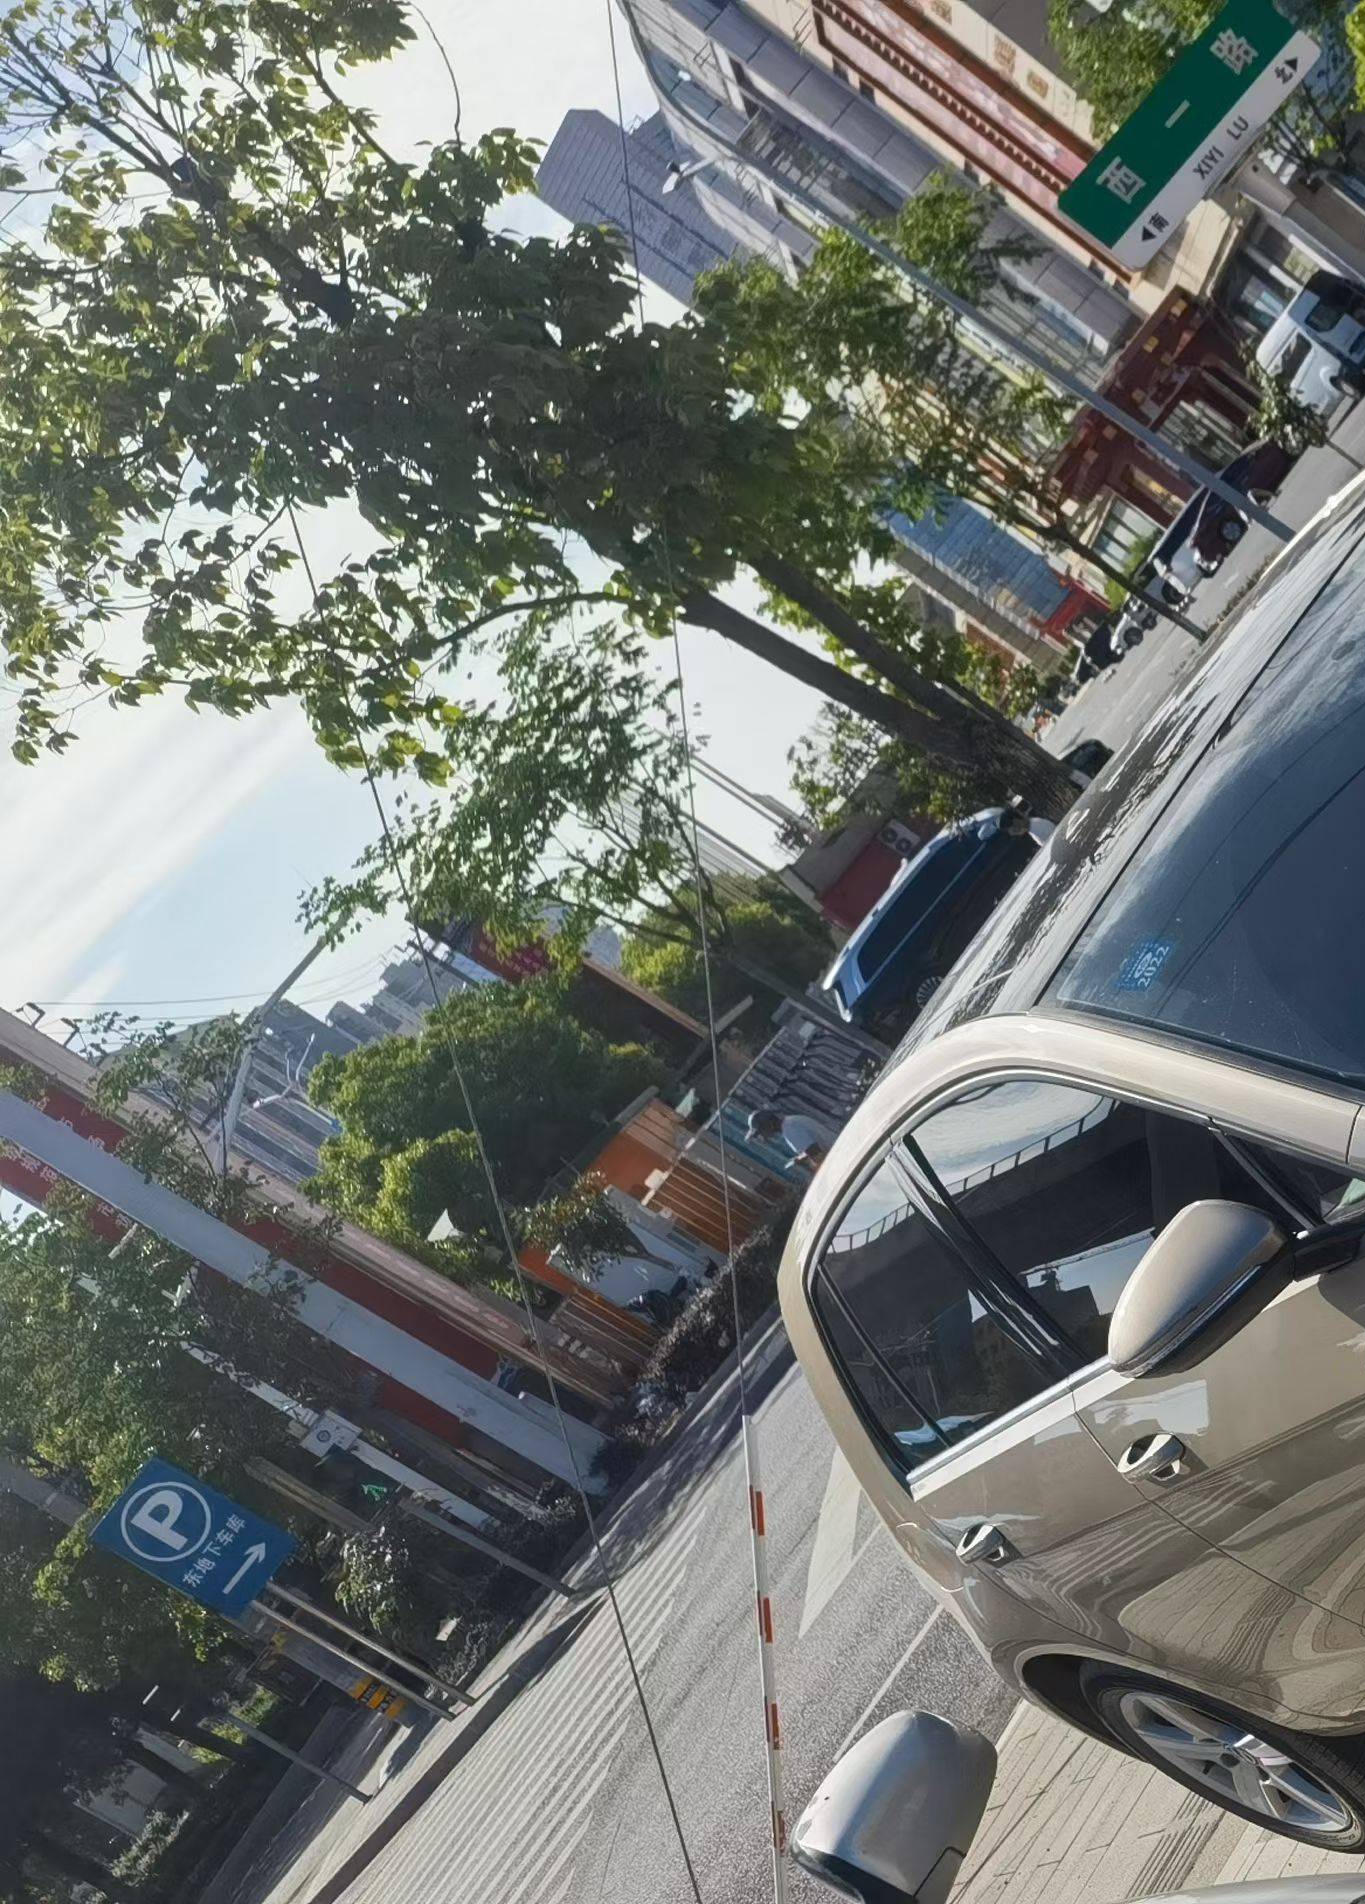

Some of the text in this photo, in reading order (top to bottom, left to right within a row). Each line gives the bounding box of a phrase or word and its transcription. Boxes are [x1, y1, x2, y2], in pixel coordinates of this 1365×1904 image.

[1096, 28, 1259, 204] 西一路
[1193, 115, 1250, 180] XIYI LU
[1137, 946, 1170, 987] 2022
[182, 1513, 247, 1588] 东地下车库
